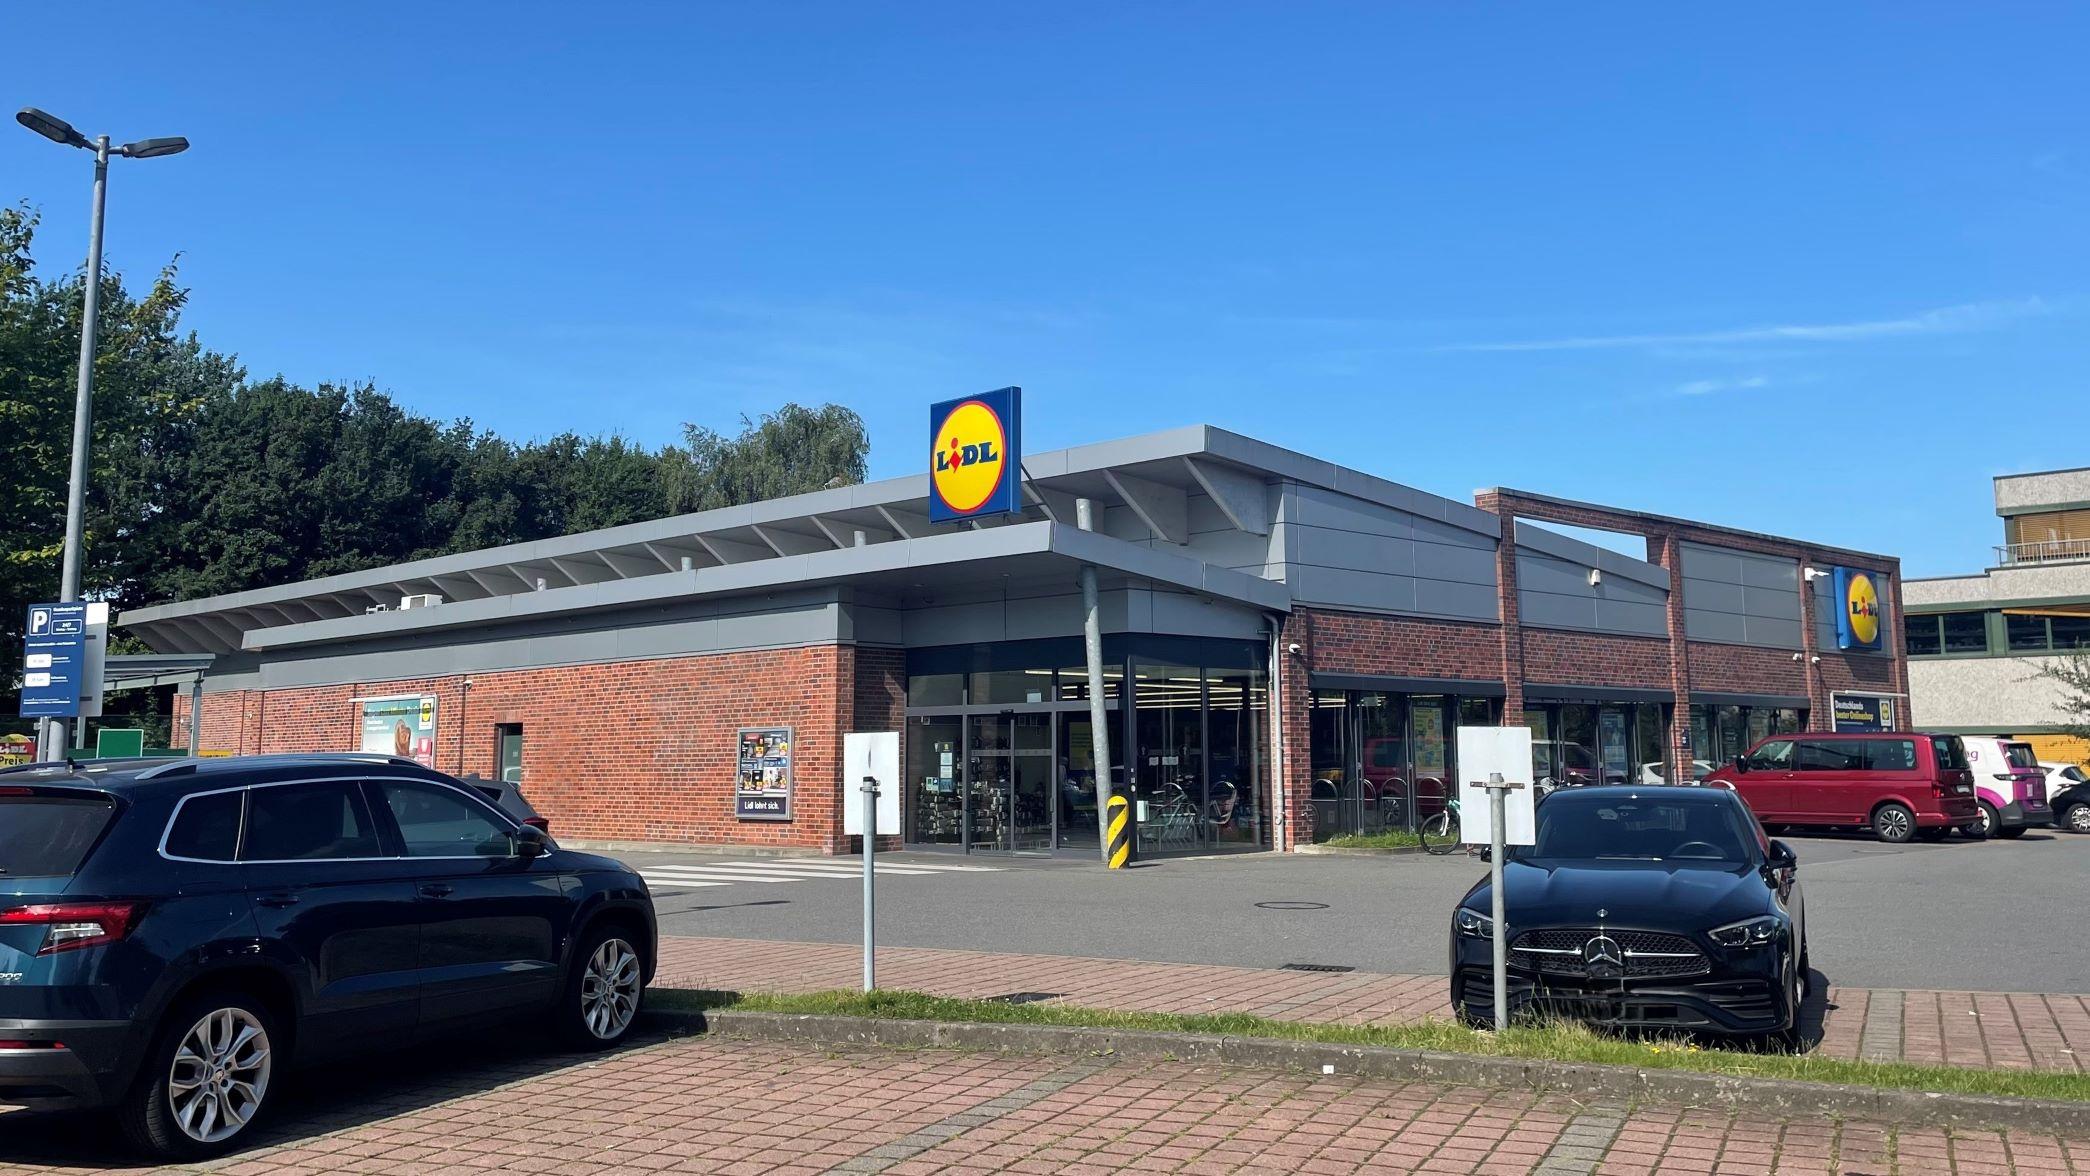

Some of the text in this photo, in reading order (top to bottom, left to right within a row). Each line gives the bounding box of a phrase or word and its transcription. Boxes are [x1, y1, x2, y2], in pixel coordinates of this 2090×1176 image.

[33, 611, 48, 633] P
[744, 801, 754, 810] Lidl
[755, 801, 767, 810] lohnt
